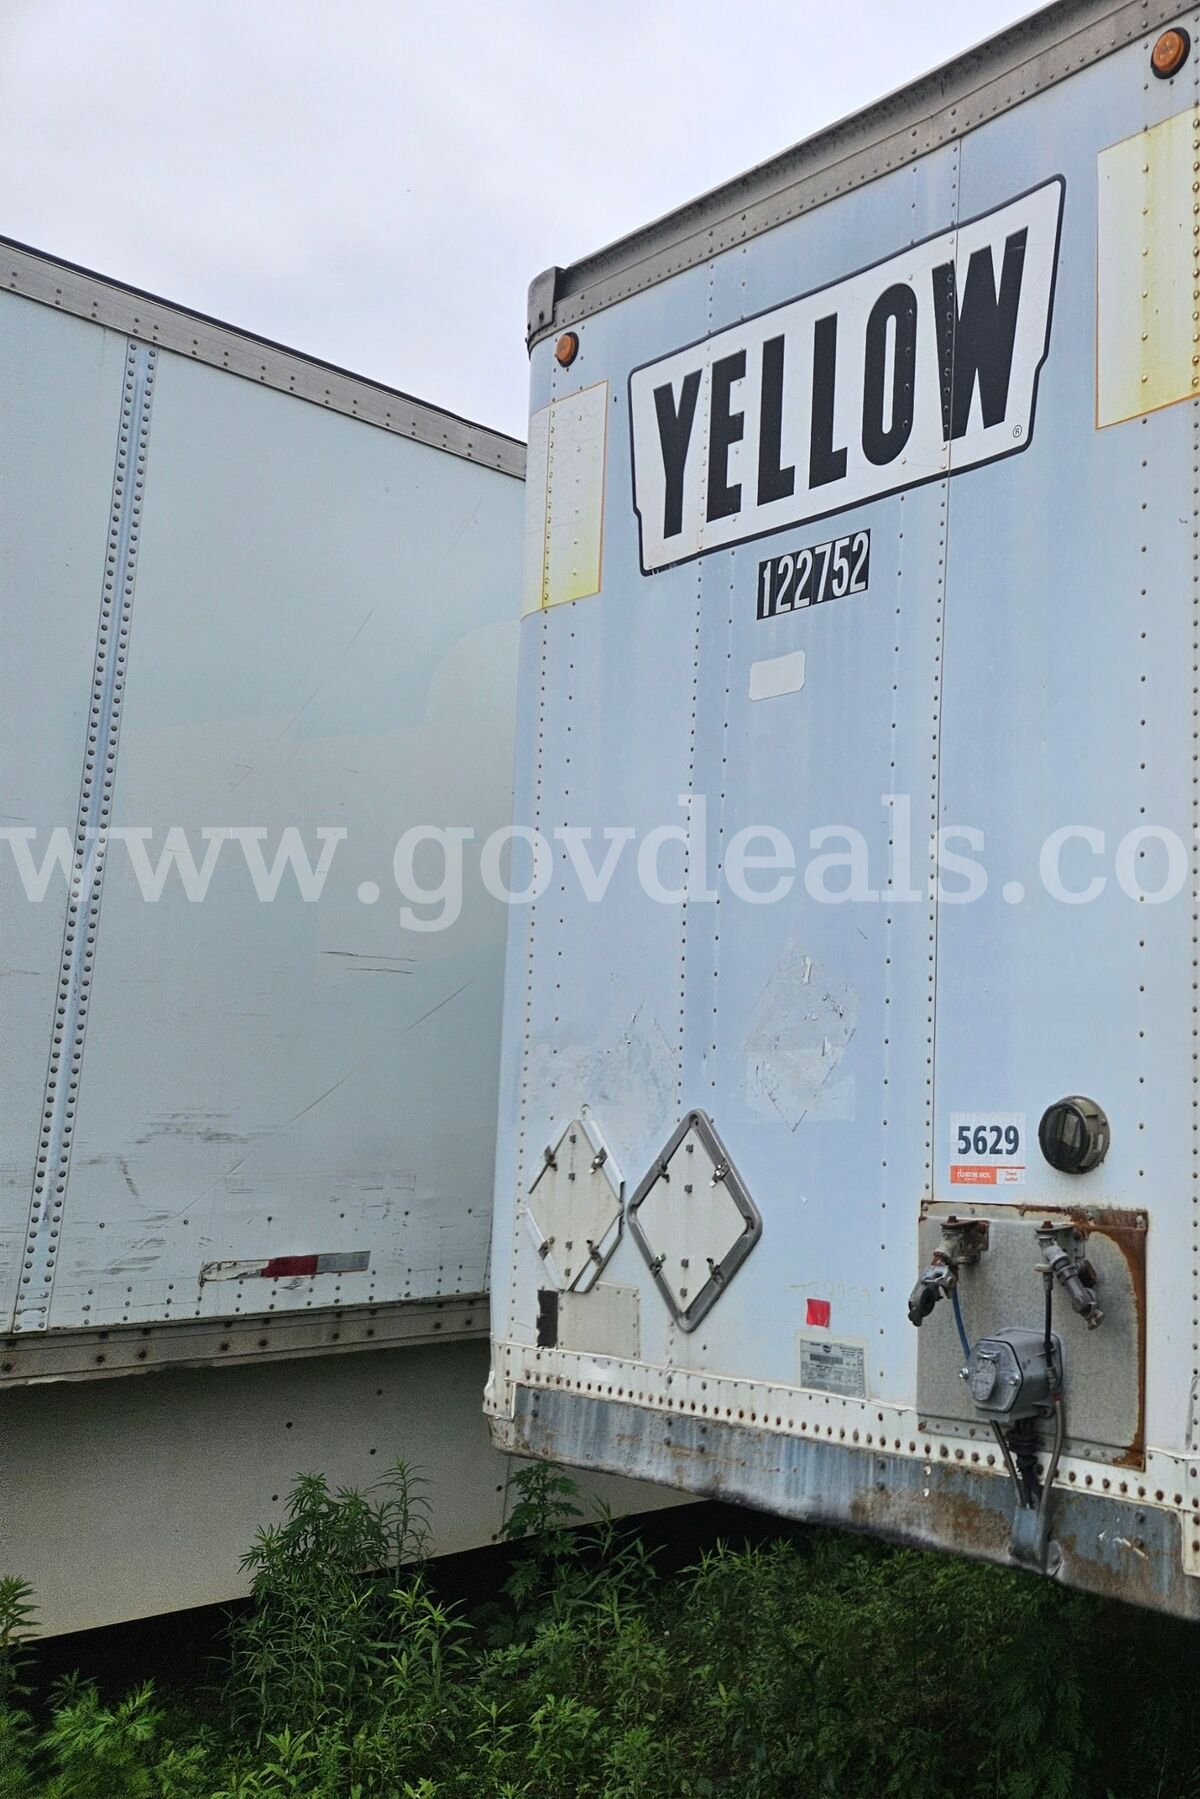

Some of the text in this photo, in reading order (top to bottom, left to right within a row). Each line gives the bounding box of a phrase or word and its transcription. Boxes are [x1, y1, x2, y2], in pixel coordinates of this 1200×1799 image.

[653, 226, 1030, 539] YELLOW
[761, 532, 868, 616] 122752
[957, 1125, 1020, 1155] 5629
